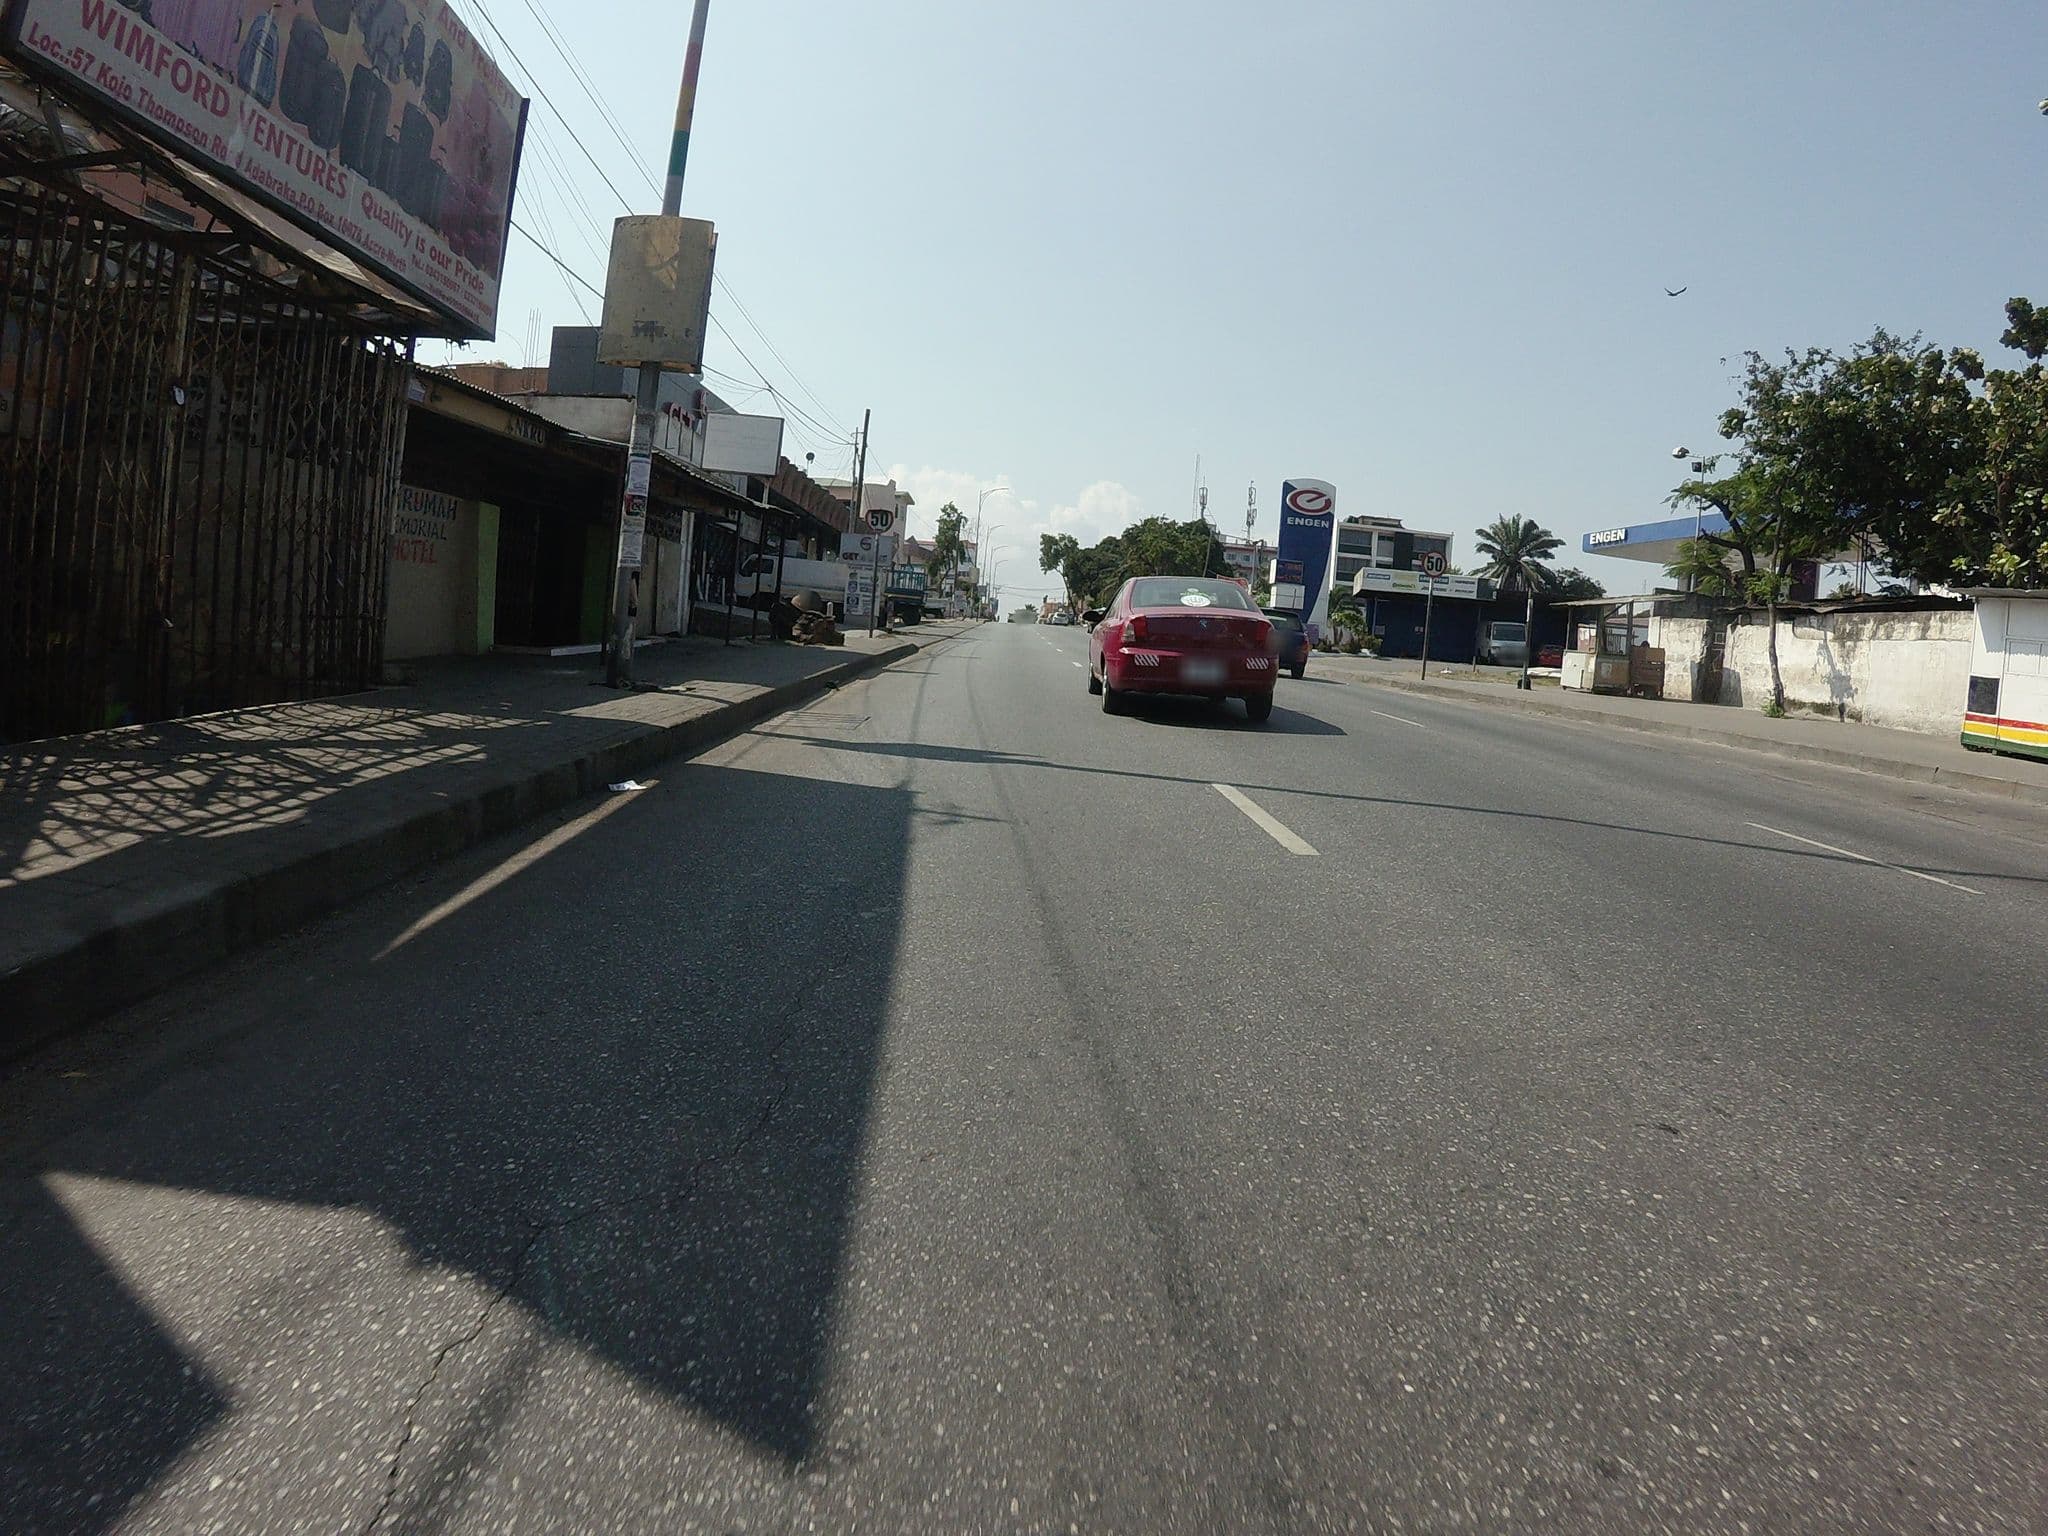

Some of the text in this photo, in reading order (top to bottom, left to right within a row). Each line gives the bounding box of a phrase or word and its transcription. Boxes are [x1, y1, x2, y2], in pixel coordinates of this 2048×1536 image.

[97, 62, 133, 101] Kojo
[80, 0, 347, 199] WIMFORD VENTURES
[361, 191, 413, 248] Quality
[416, 235, 426, 254] is
[430, 246, 451, 270] our
[456, 258, 485, 294] Pride
[870, 512, 889, 527] 50
[1286, 516, 1329, 529] ENGEN
[1589, 528, 1626, 545] ENGEN
[1426, 557, 1443, 573] 50
